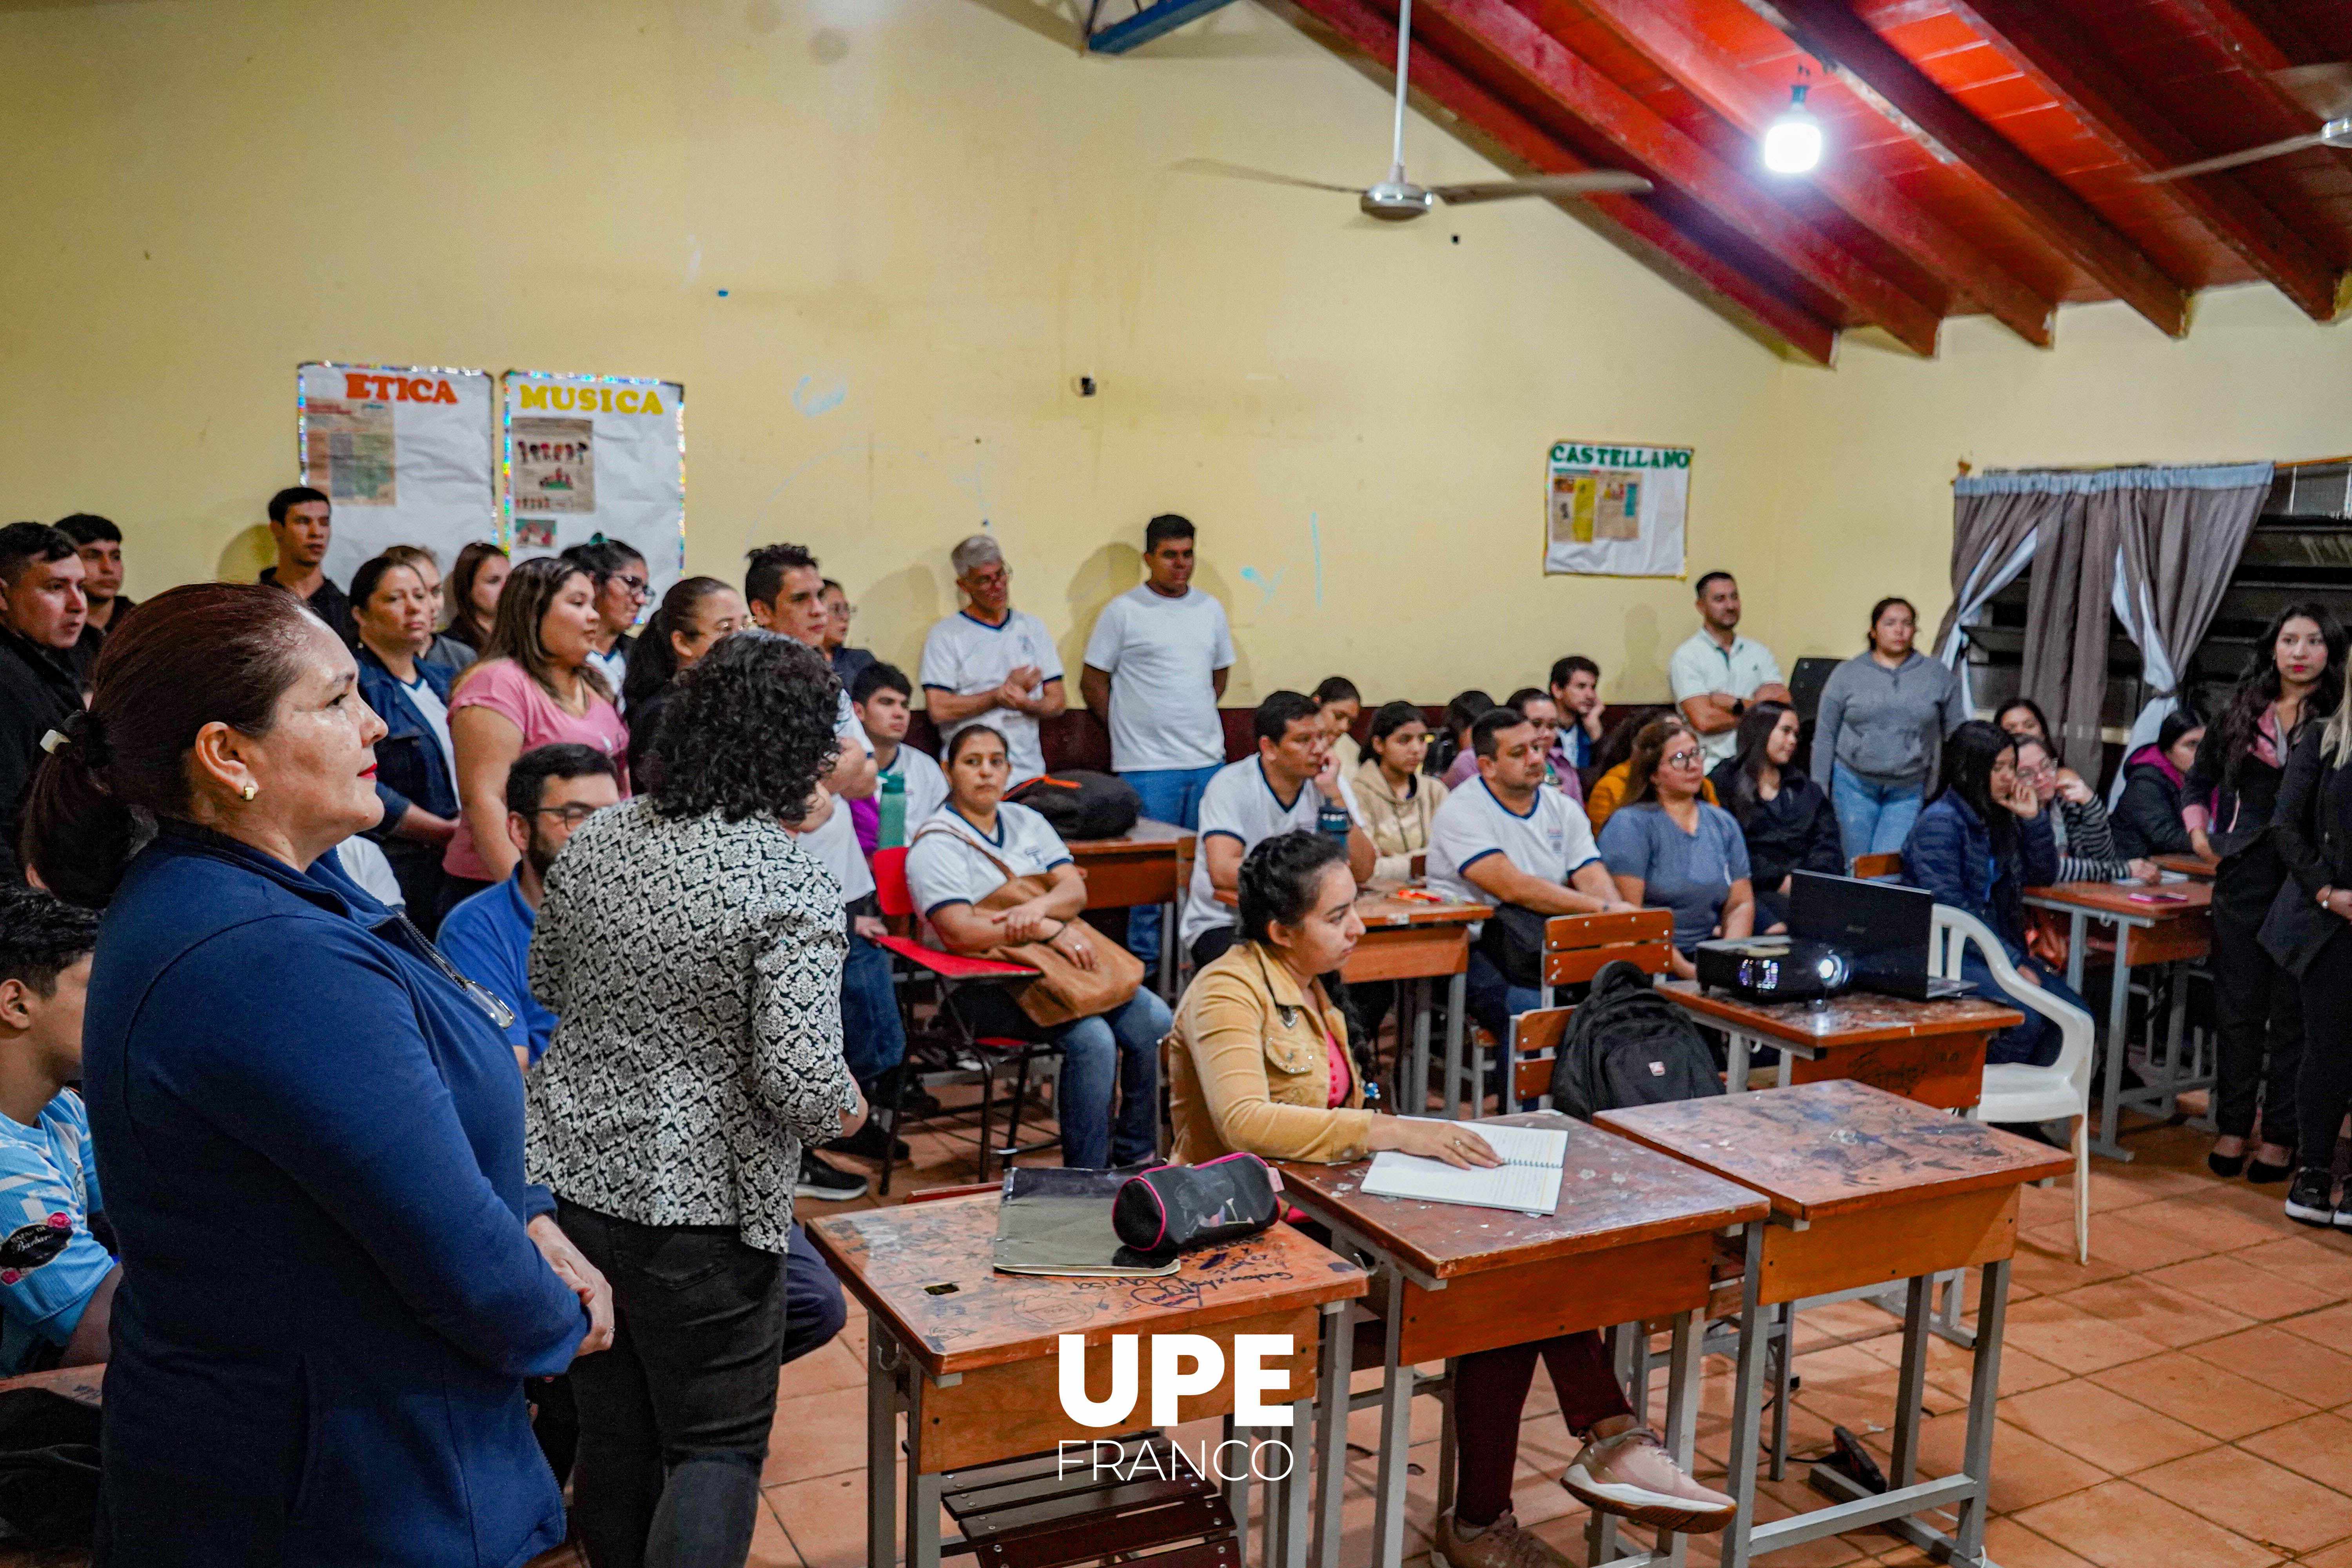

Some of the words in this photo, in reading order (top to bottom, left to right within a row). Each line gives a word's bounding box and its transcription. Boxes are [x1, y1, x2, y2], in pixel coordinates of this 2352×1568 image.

[345, 373, 457, 404] ETICA
[519, 384, 664, 415] MUSICA
[1550, 445, 1690, 469] CASTELLANO
